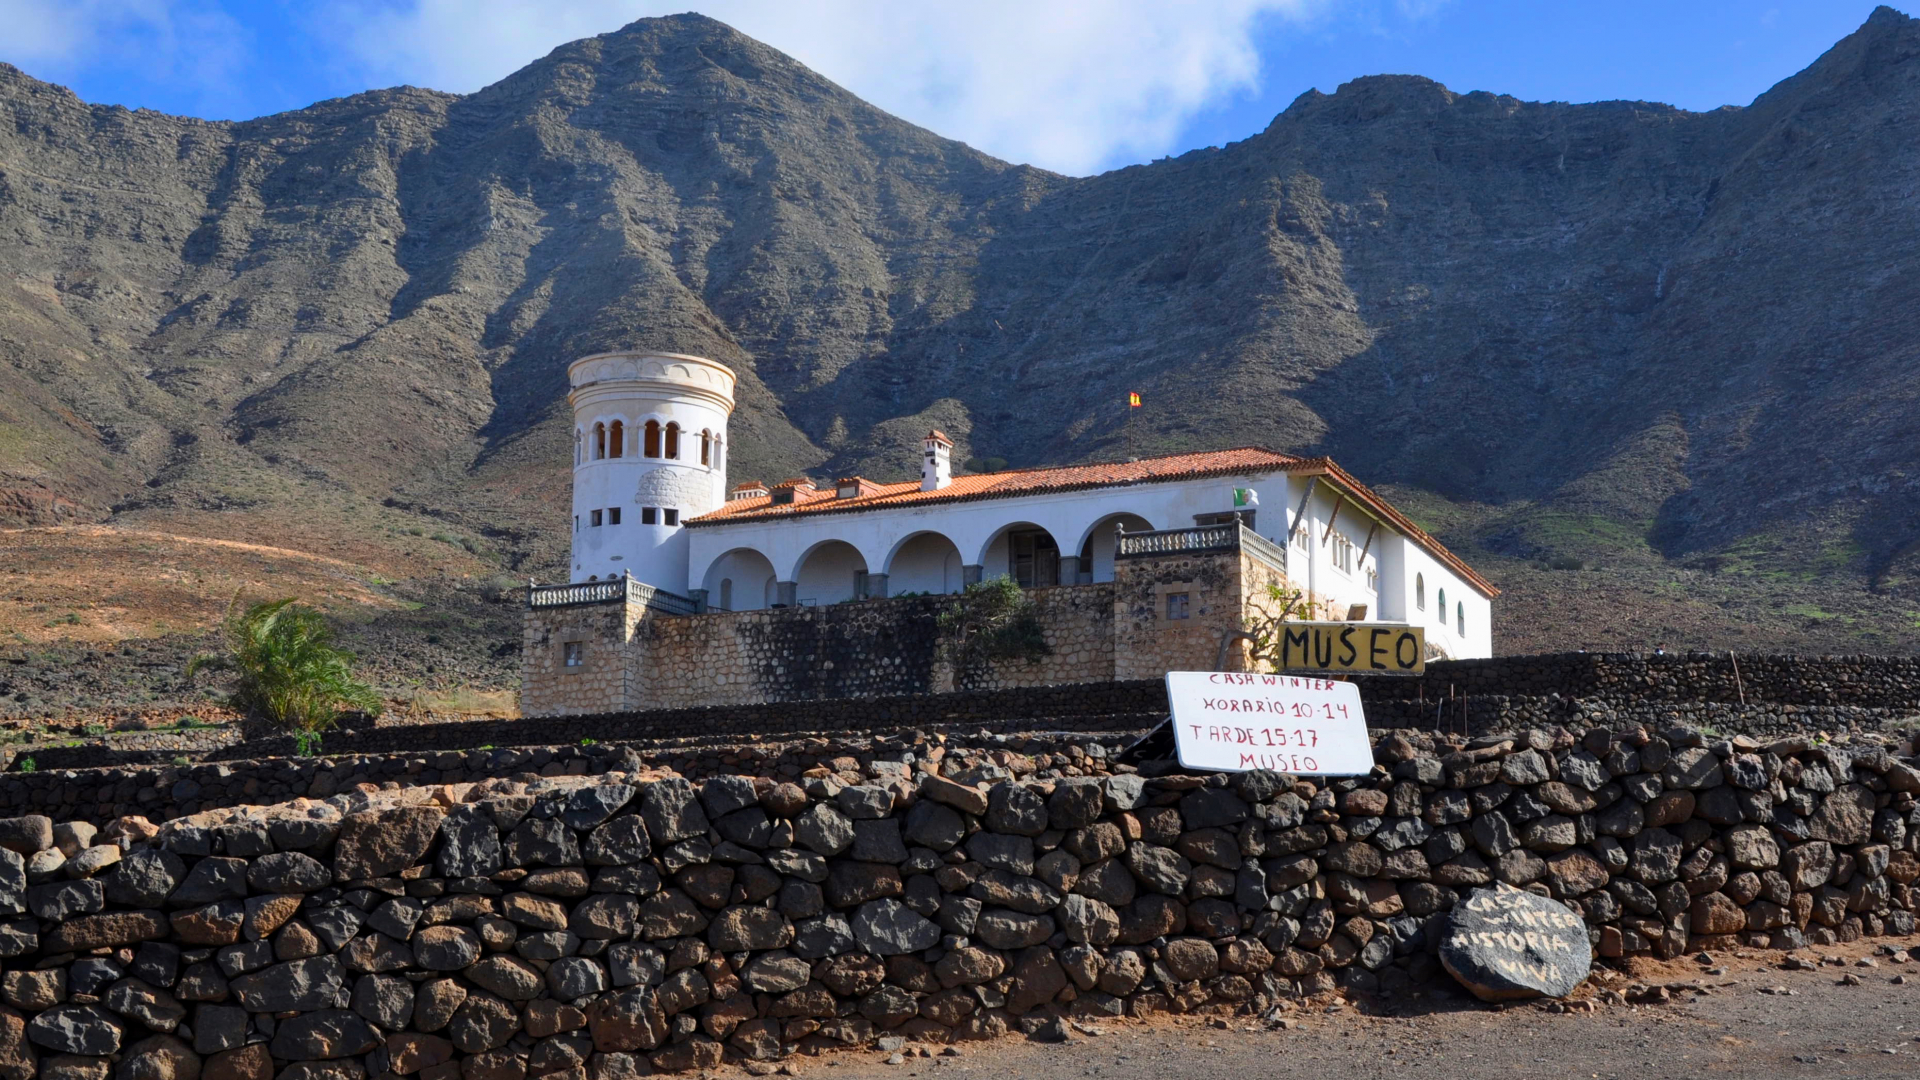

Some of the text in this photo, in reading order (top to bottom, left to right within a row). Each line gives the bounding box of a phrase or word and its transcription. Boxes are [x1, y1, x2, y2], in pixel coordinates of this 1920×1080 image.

[1283, 624, 1418, 669] MUSEO
[1261, 675, 1335, 691] WINTER
[1203, 696, 1285, 714] HORARIO
[1189, 725, 1258, 746] TARDE
[1240, 753, 1318, 771] MUSEO
[1466, 895, 1533, 912] CASA
[1482, 909, 1581, 929] WINTER
[1451, 929, 1570, 952] HISTORIA
[1498, 958, 1563, 982] VIVA
